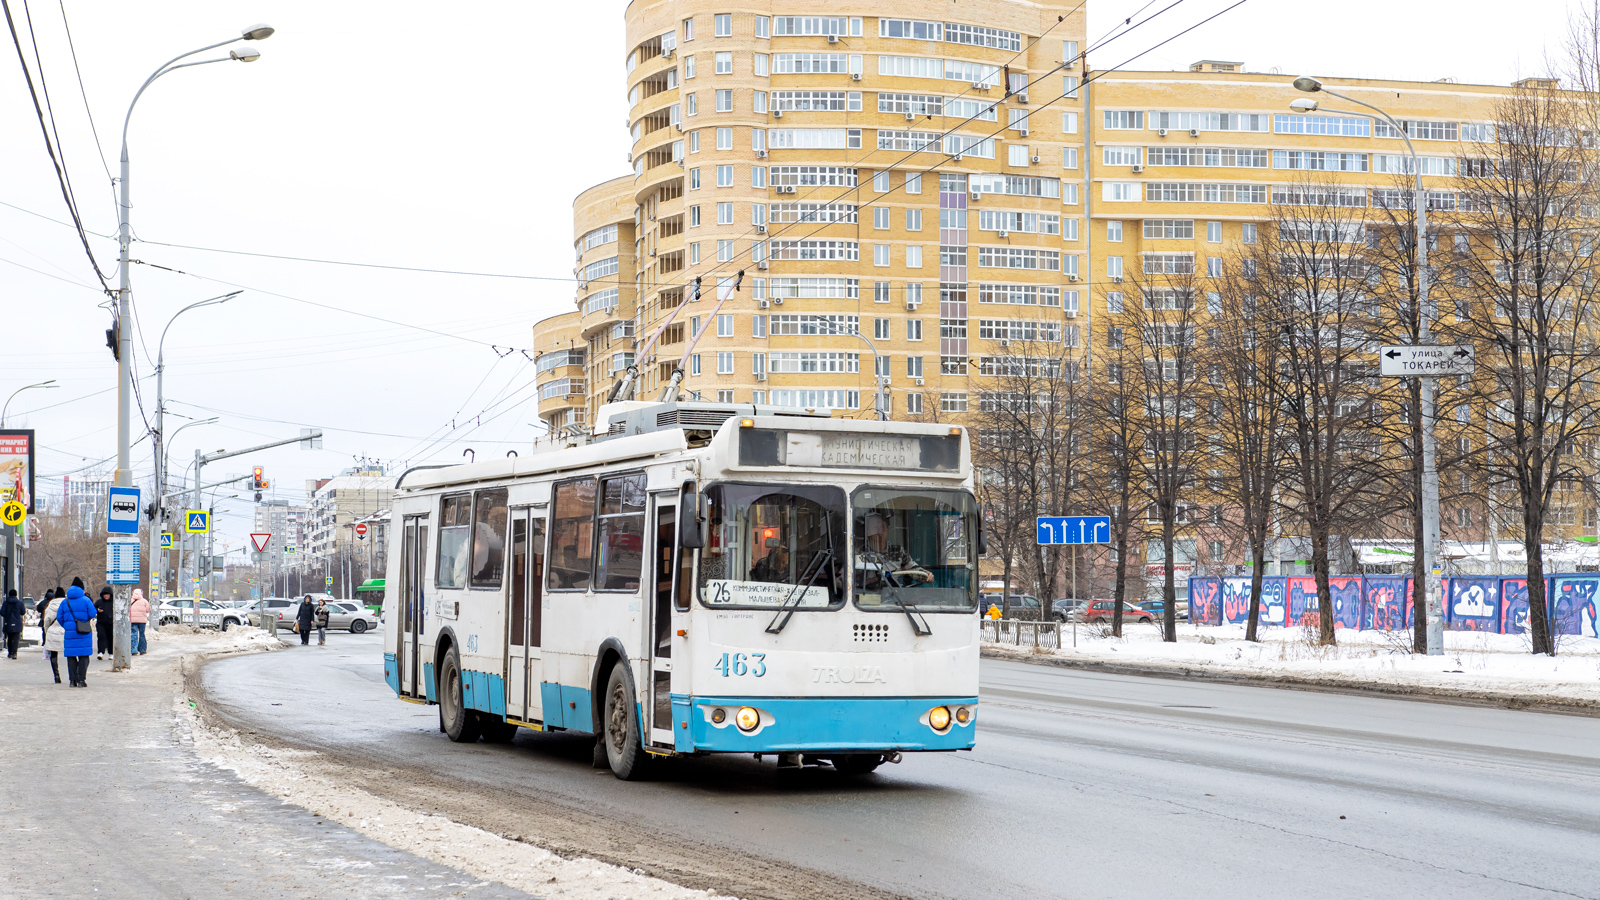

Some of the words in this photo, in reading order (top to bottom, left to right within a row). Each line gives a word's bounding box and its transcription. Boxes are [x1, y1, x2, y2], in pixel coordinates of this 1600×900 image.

[1411, 350, 1443, 359] улица
[1402, 361, 1454, 370] ТОКАРЕЙ
[15, 446, 27, 454] ЦЕН
[713, 582, 730, 603] 26
[466, 633, 479, 654] 463
[713, 652, 767, 678] 463
